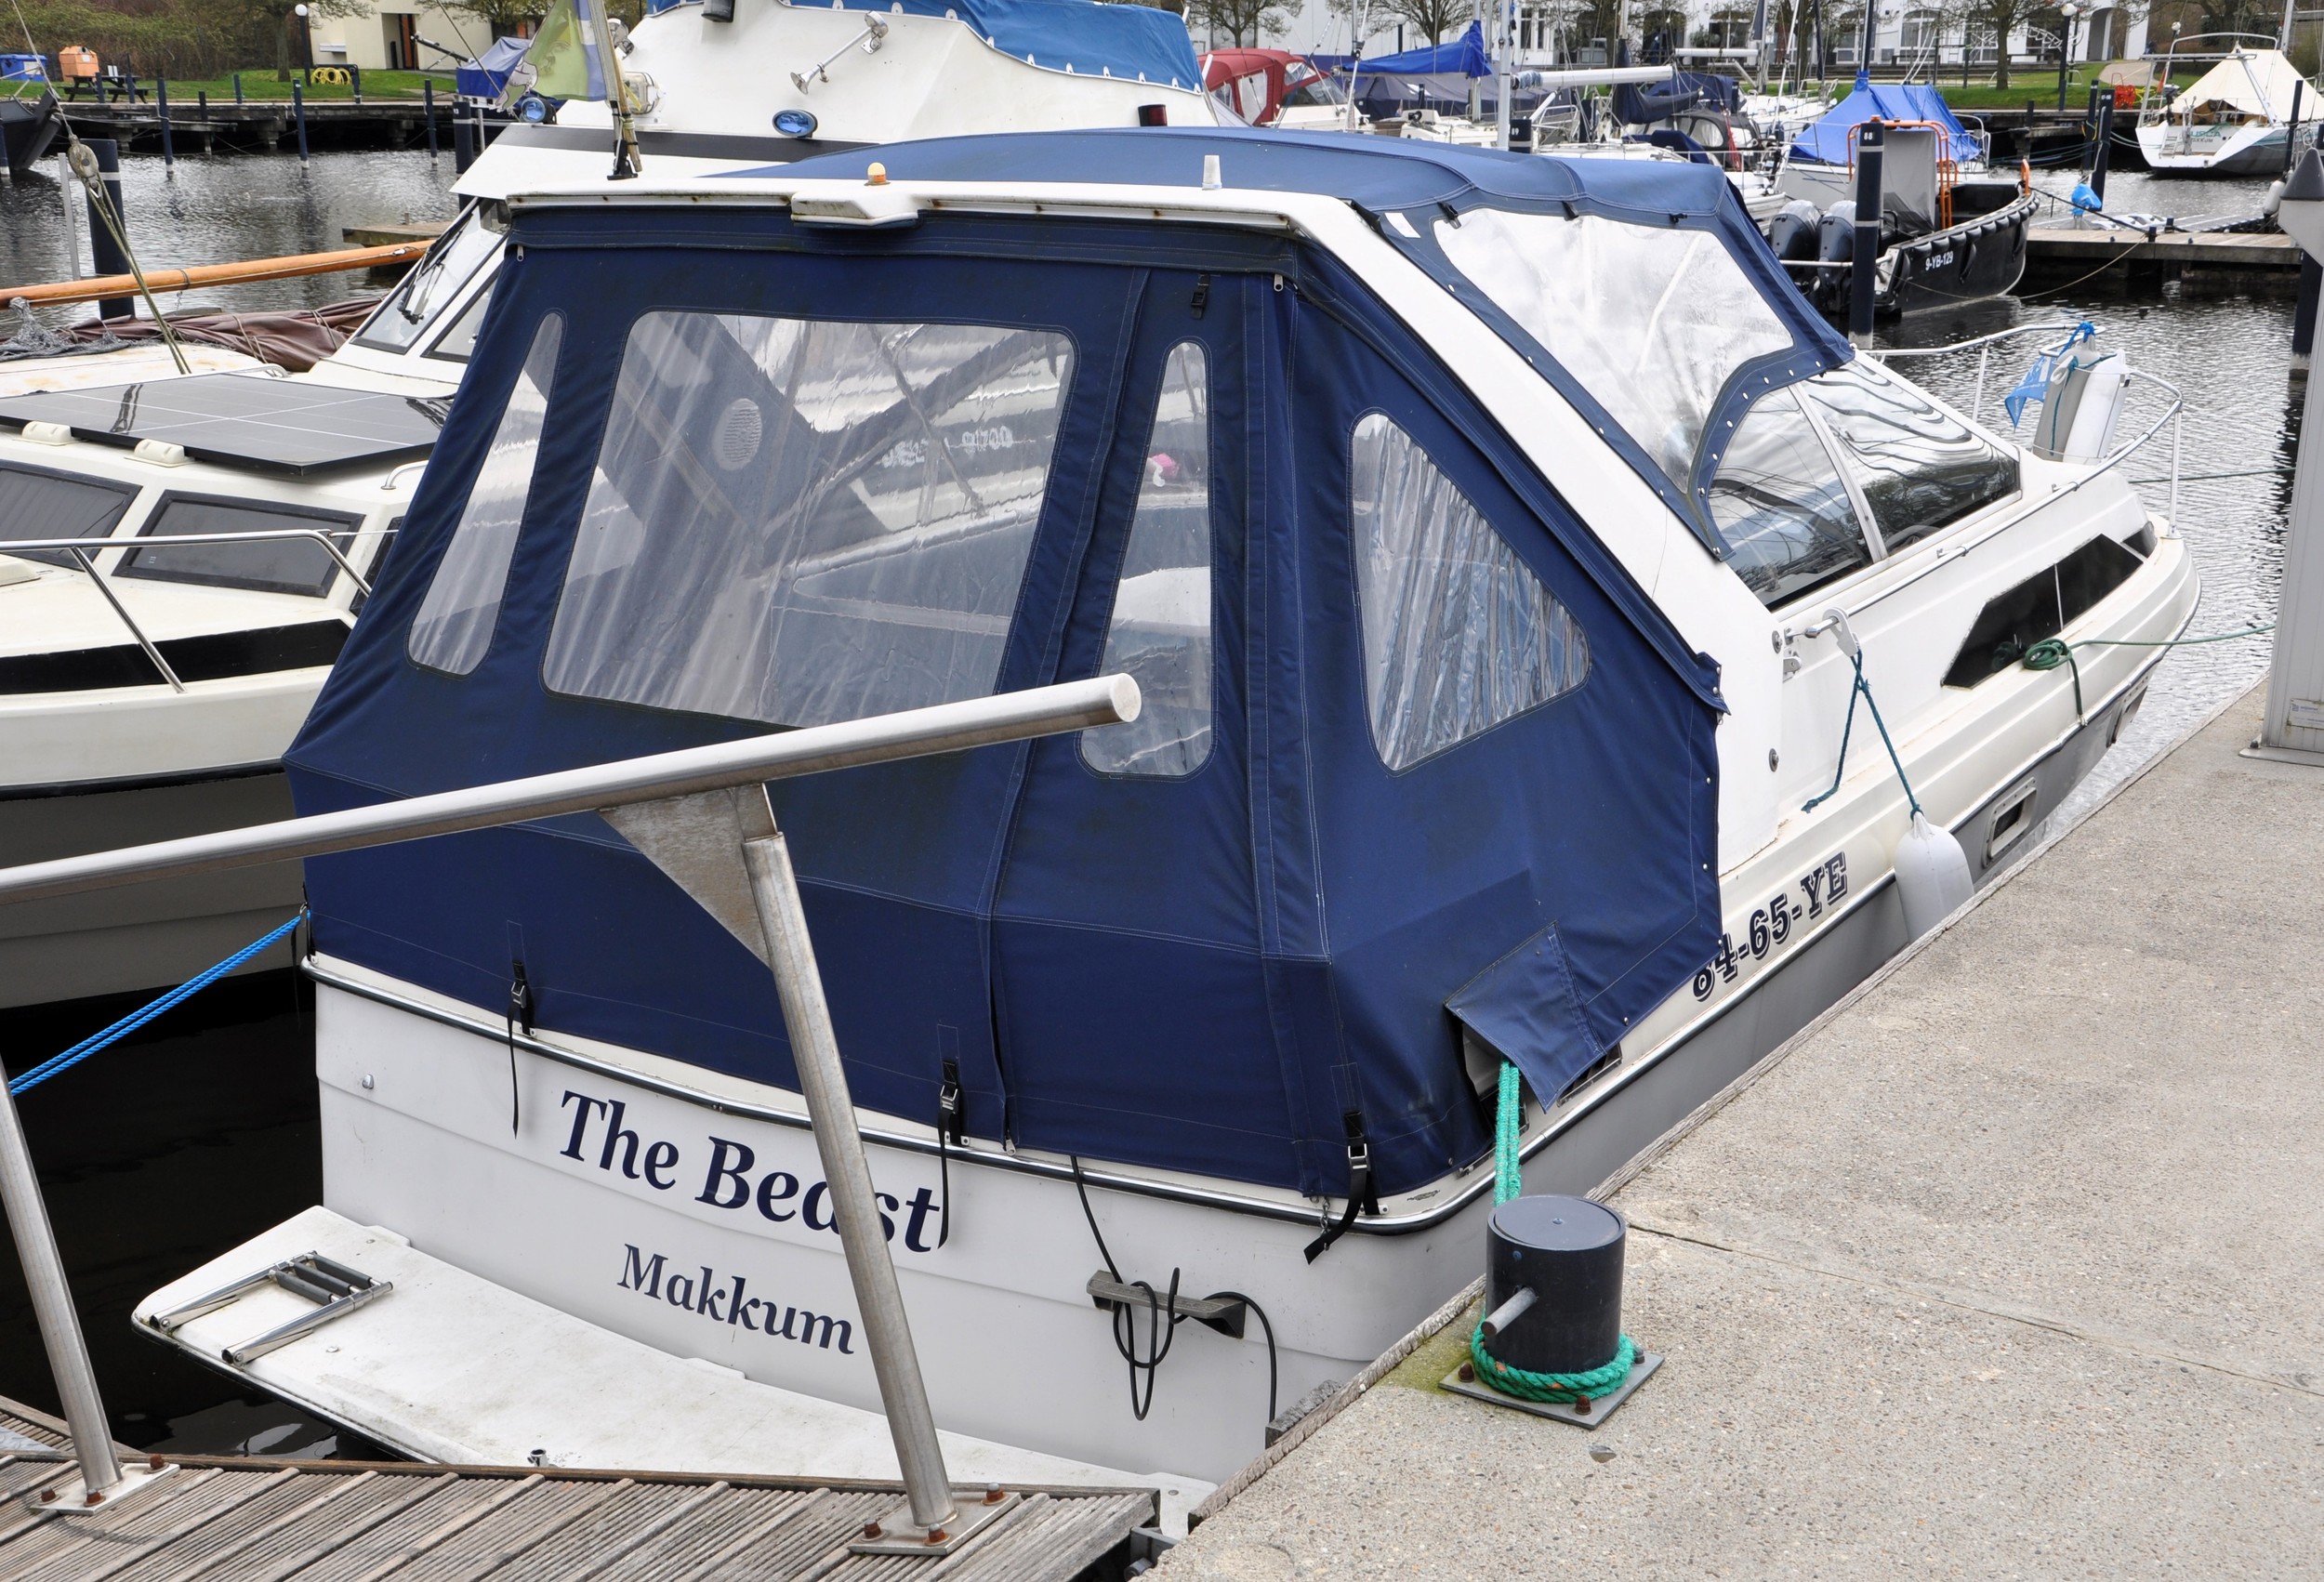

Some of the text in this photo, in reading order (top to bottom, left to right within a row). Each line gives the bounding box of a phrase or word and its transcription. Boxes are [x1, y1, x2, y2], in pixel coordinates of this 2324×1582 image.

[1864, 132, 1873, 140] 88
[1925, 251, 1954, 270] 9-YB-129
[560, 1089, 940, 1253] The Beast
[617, 1244, 854, 1354] Makkum
